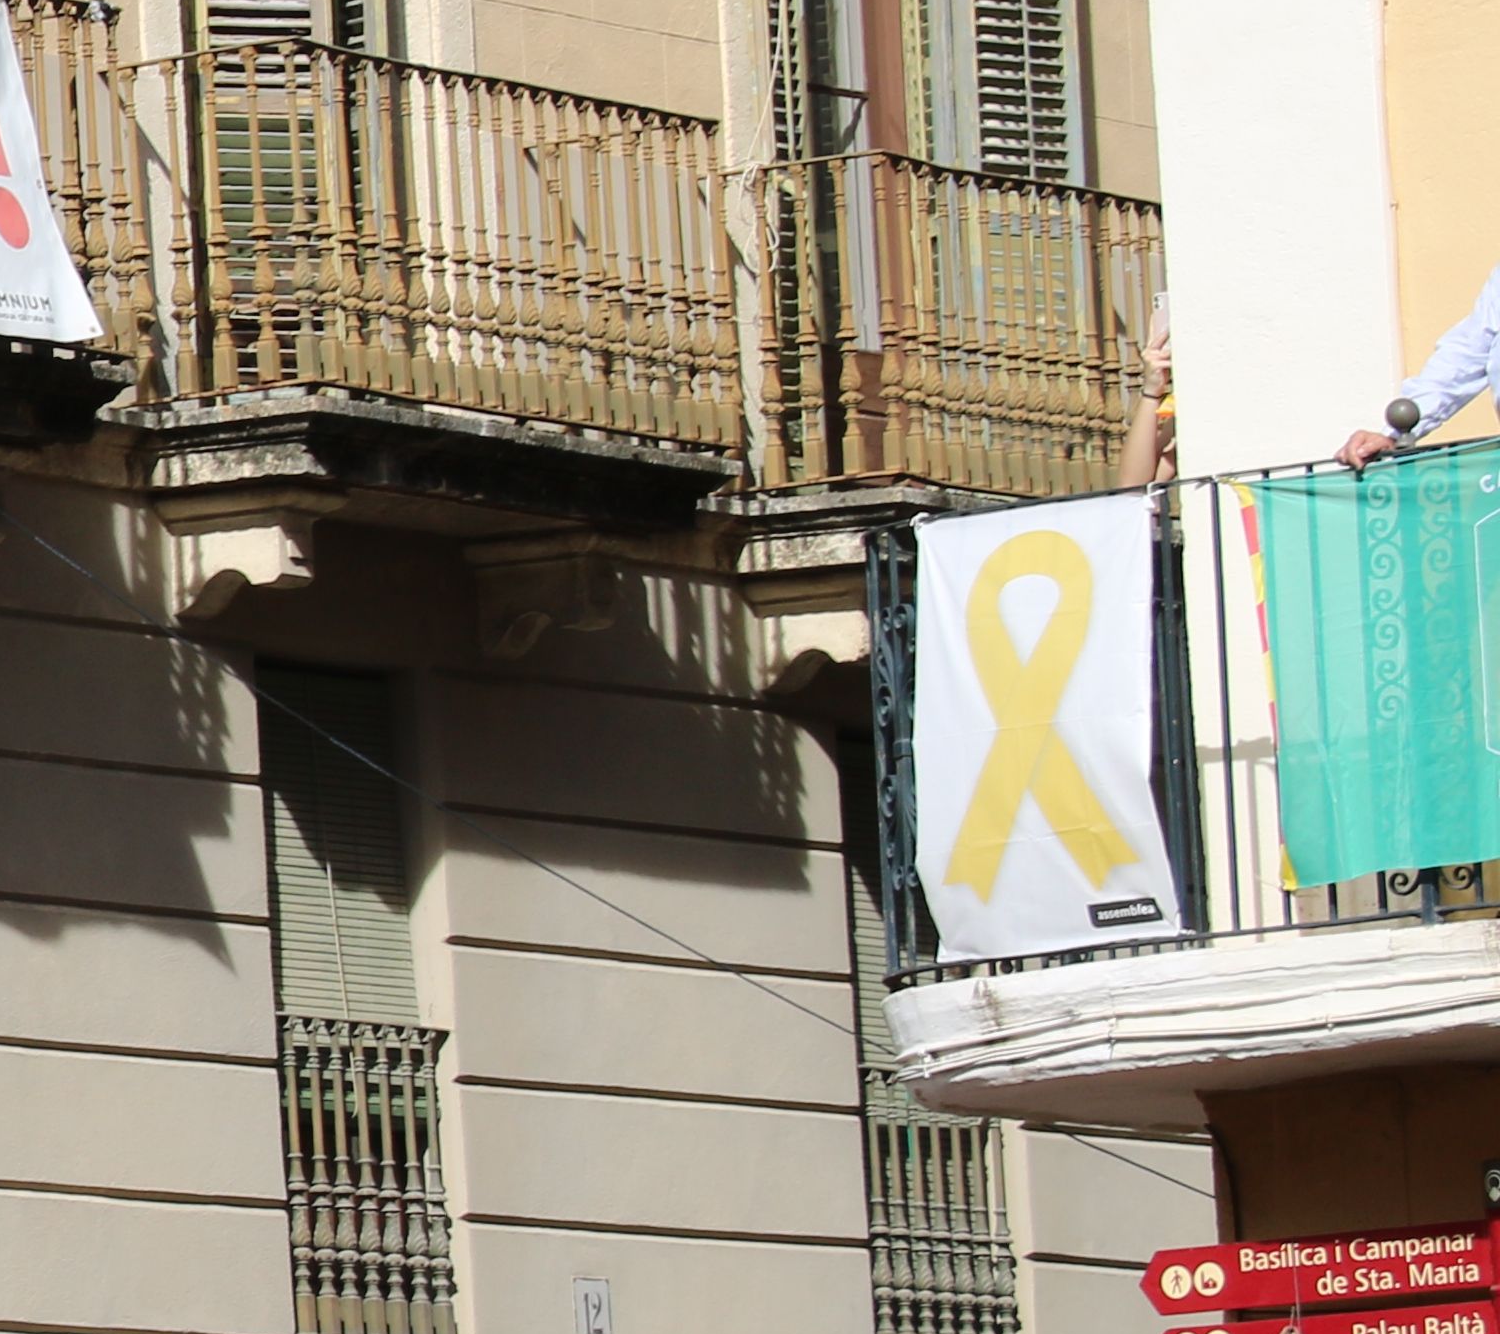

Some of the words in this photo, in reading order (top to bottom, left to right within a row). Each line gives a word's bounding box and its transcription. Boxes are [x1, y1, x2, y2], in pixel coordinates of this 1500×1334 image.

[1097, 903, 1156, 920] assemblea
[1239, 1242, 1327, 1272] Basílica
[1334, 1239, 1343, 1263] i
[1349, 1232, 1475, 1262] Campanar
[1316, 1270, 1349, 1296] de
[1355, 1268, 1401, 1293] Sta.
[1408, 1258, 1480, 1288] Maria
